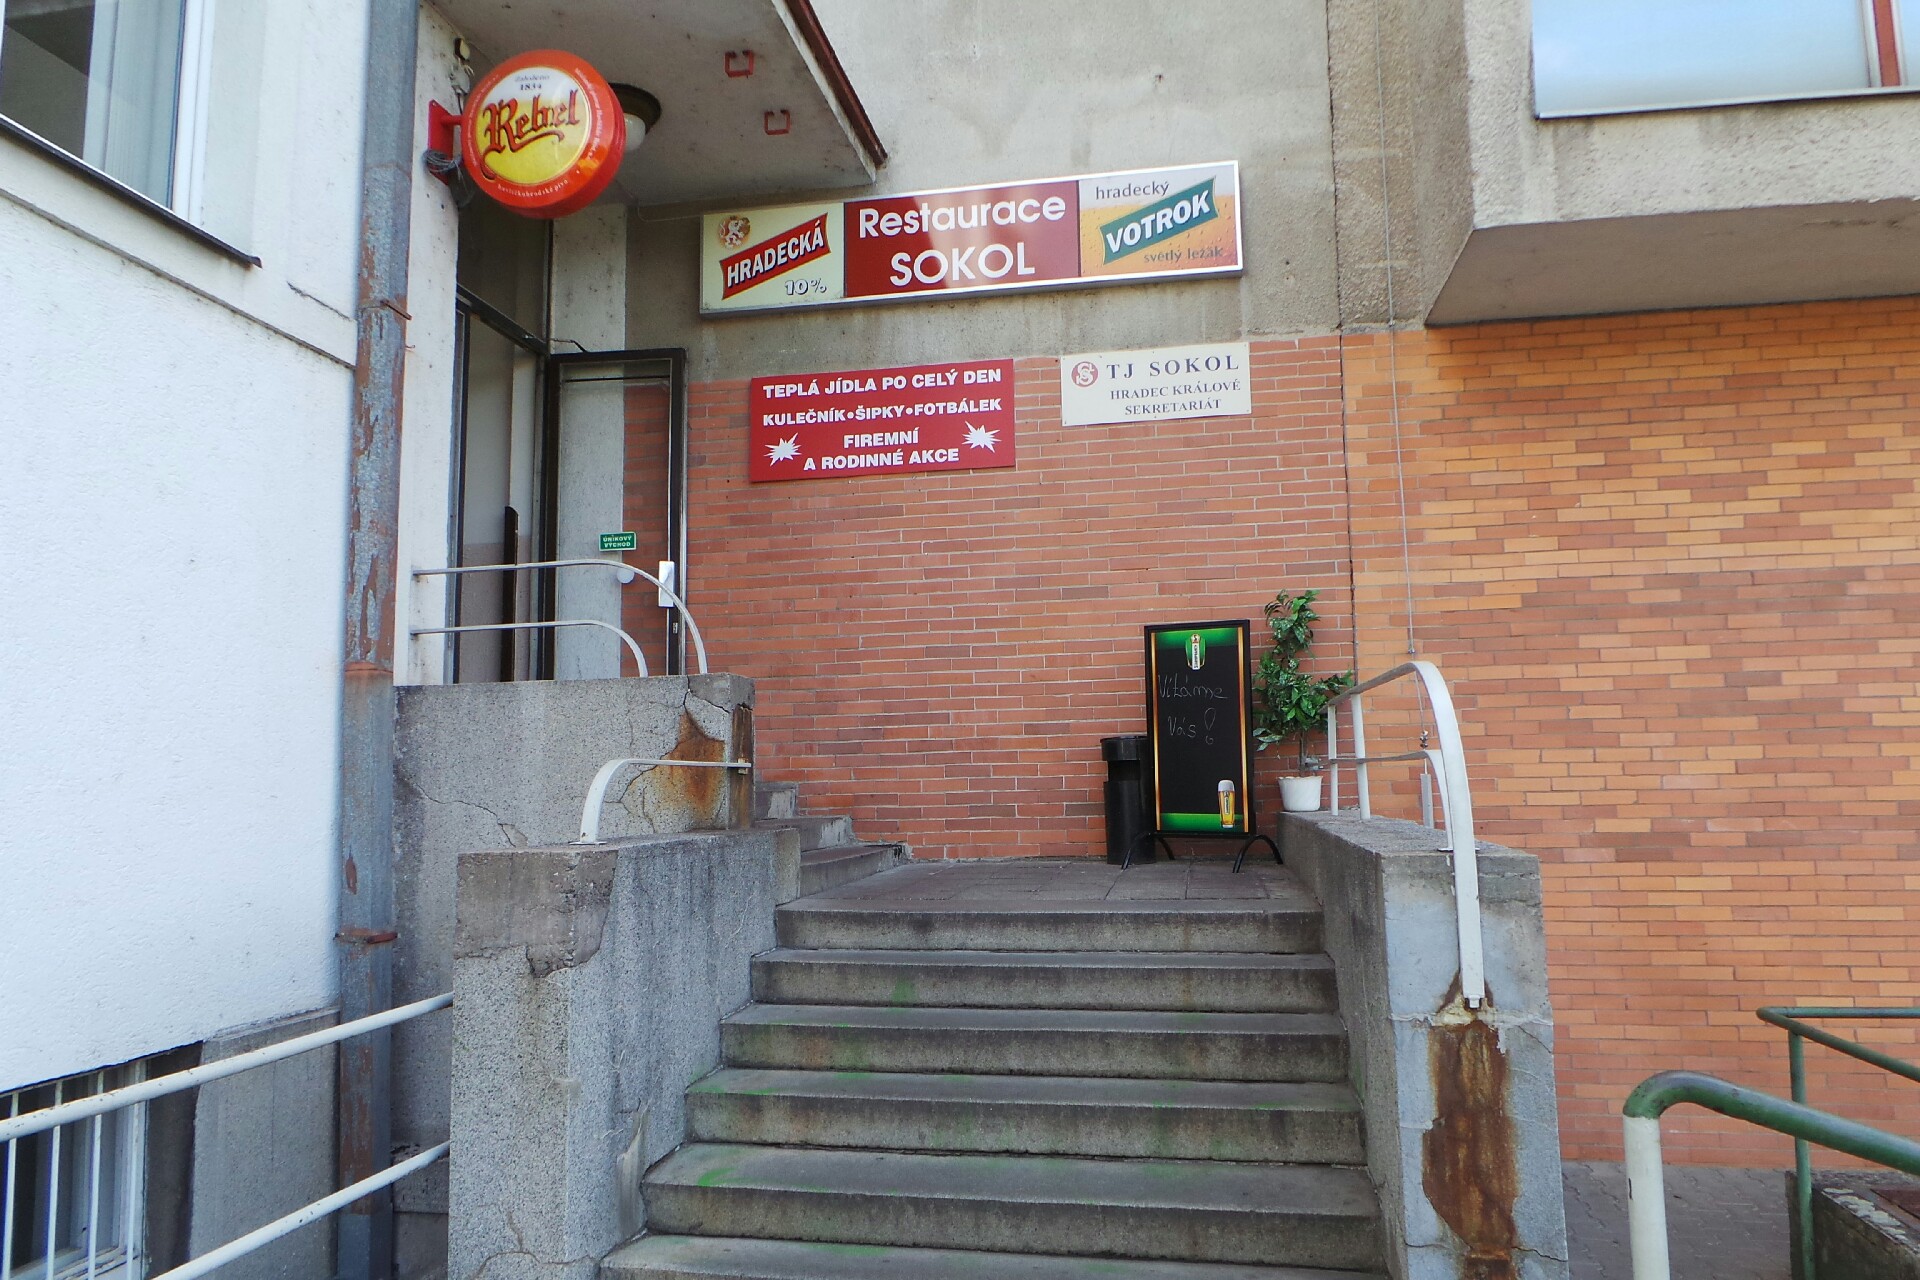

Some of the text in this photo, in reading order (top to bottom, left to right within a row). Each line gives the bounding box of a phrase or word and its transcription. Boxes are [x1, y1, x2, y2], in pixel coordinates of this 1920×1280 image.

[482, 88, 581, 155] Rebel
[1095, 181, 1170, 200] hradecký
[859, 196, 1066, 239] Restaurace
[1105, 189, 1211, 254] VOTROK
[726, 219, 826, 288] HRADECKÁ
[889, 242, 1036, 287] SOKOL
[1187, 245, 1224, 260] ležák
[1106, 354, 1239, 379] TJ SOKOL
[763, 368, 1002, 399] TEPLÁ JÍDLA PO CELÝ DEN
[1110, 378, 1241, 400] HRADEC KRÁLOVÉ
[1124, 397, 1222, 416] SEKRETARIÁT
[843, 427, 920, 449] FIREMNÍ
[803, 448, 960, 471] A RODINNÉ AKCE
